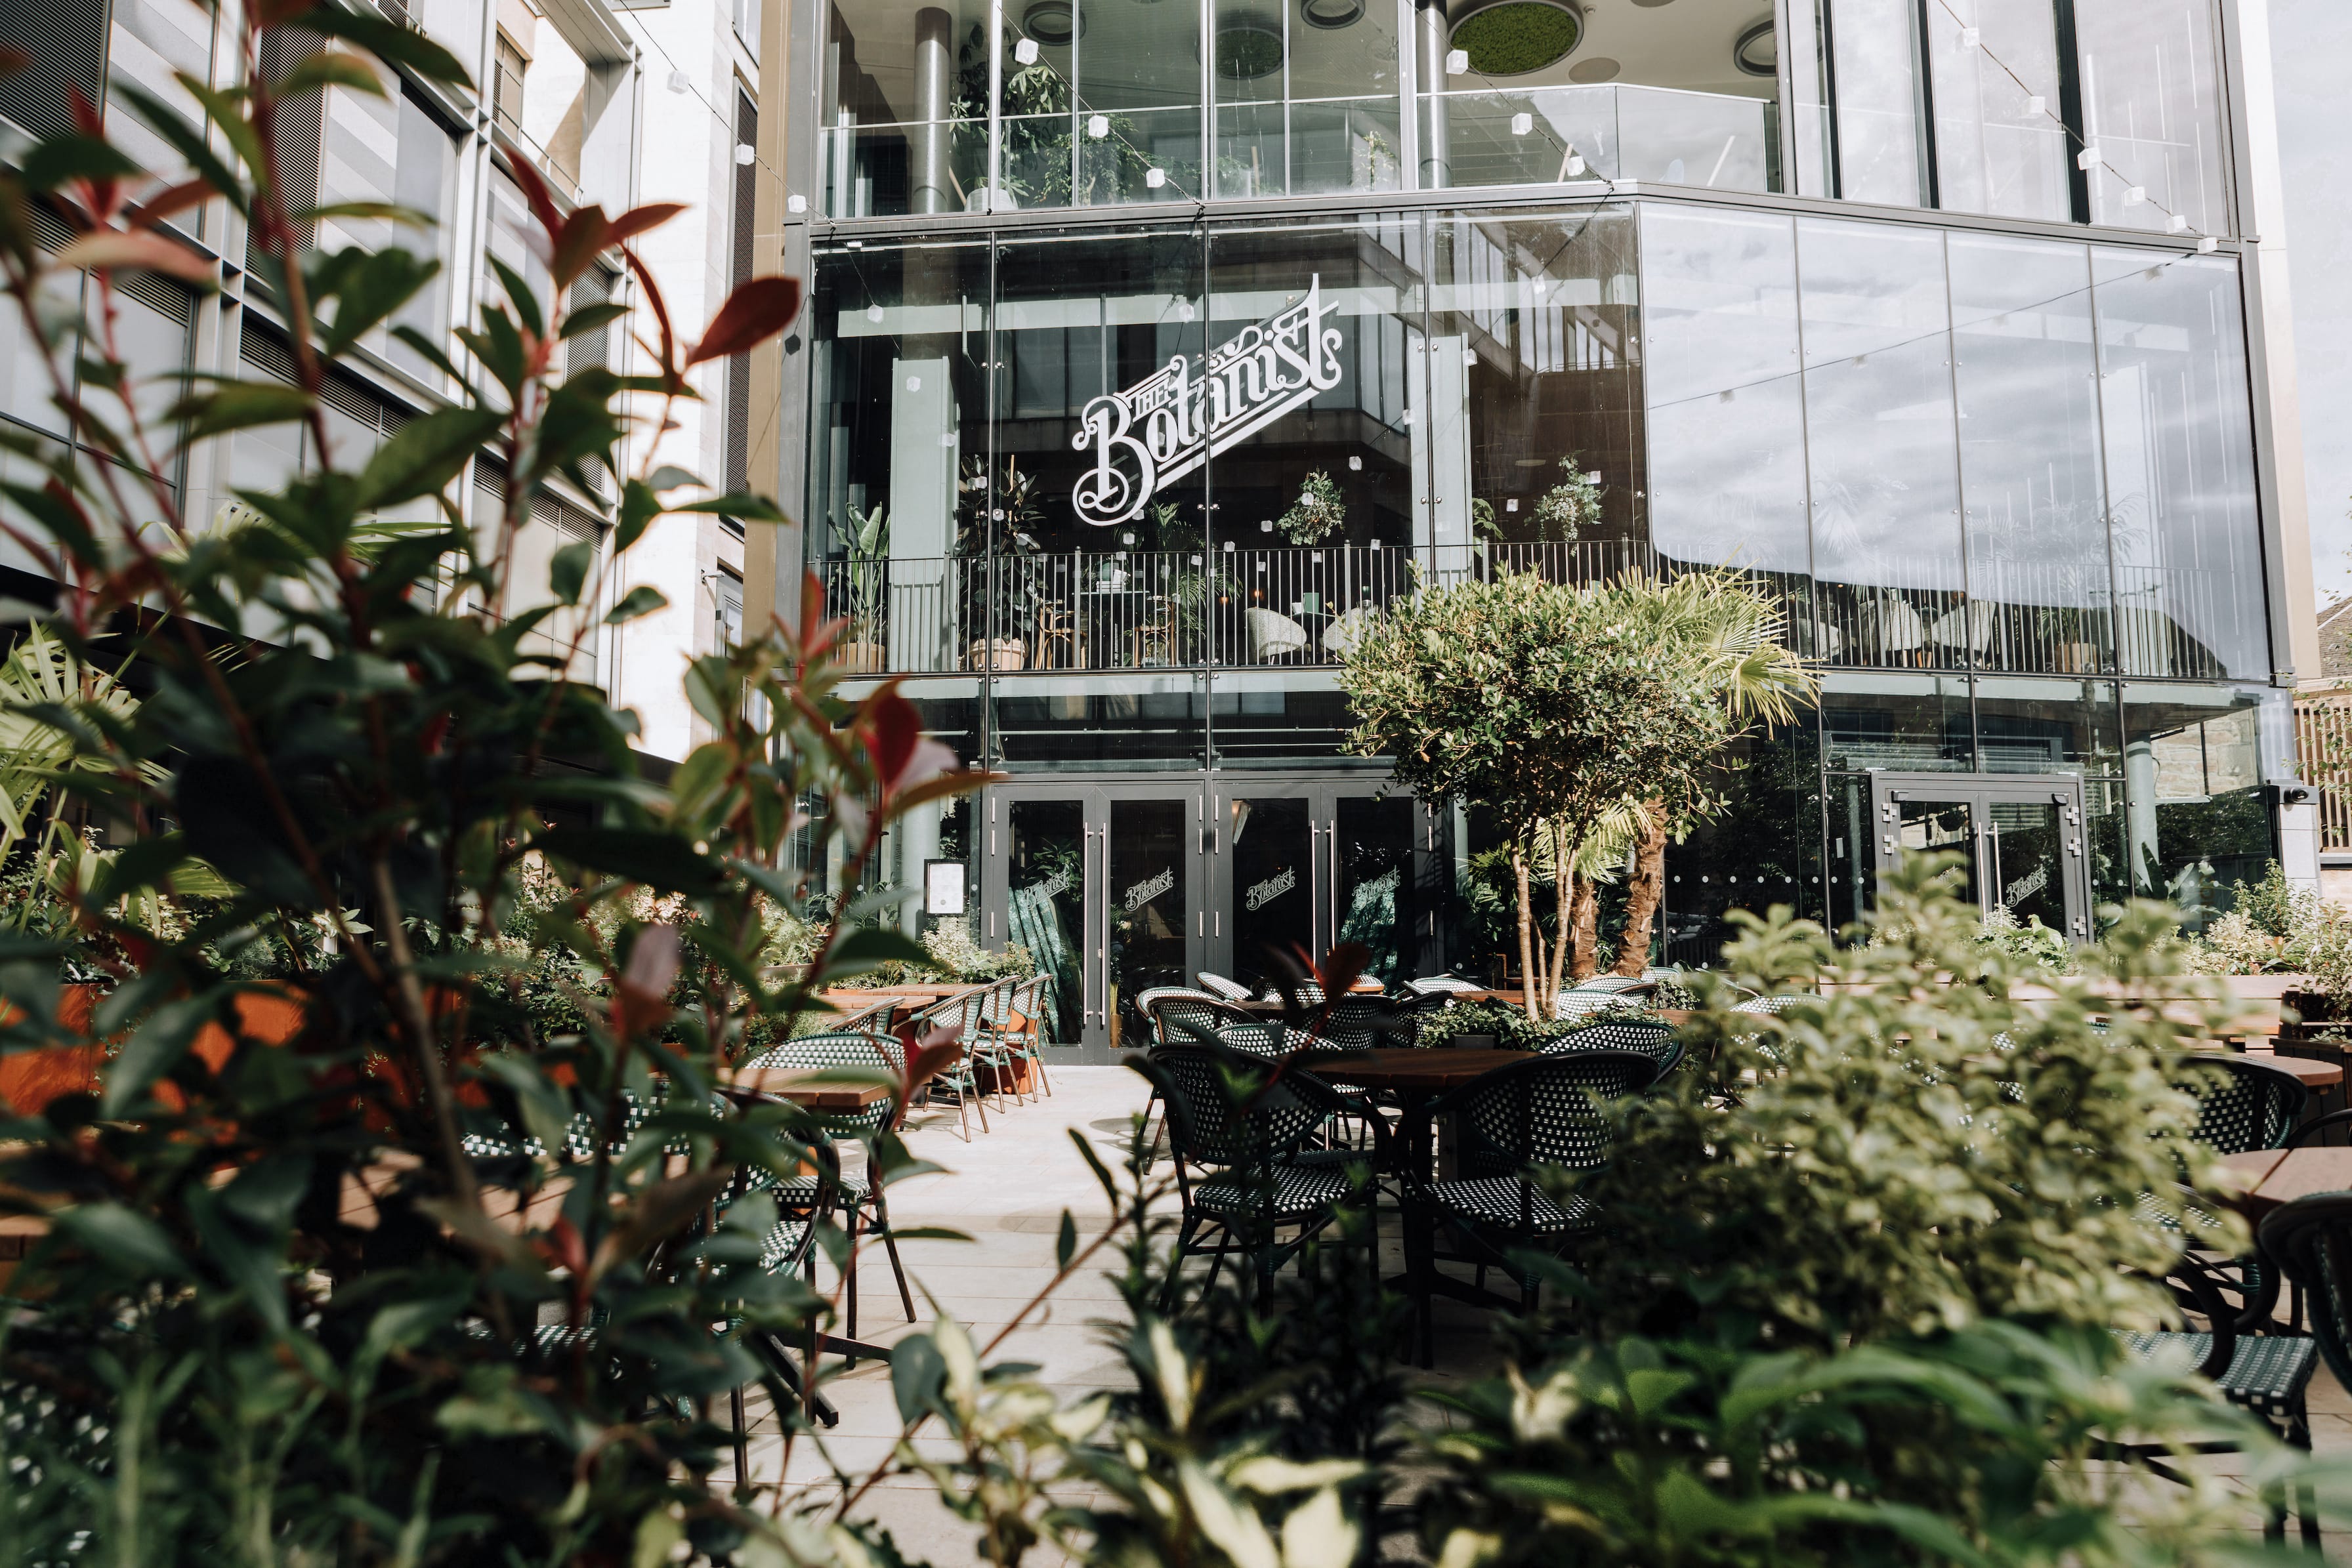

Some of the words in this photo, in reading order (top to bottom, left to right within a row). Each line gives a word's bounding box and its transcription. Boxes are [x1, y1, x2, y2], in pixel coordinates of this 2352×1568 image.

[1072, 273, 1343, 526] Botanist
[1127, 376, 1172, 424] THE
[1125, 865, 1173, 911] Botanist
[1246, 865, 1295, 911] Botanist
[2006, 863, 2048, 907] Botanist
